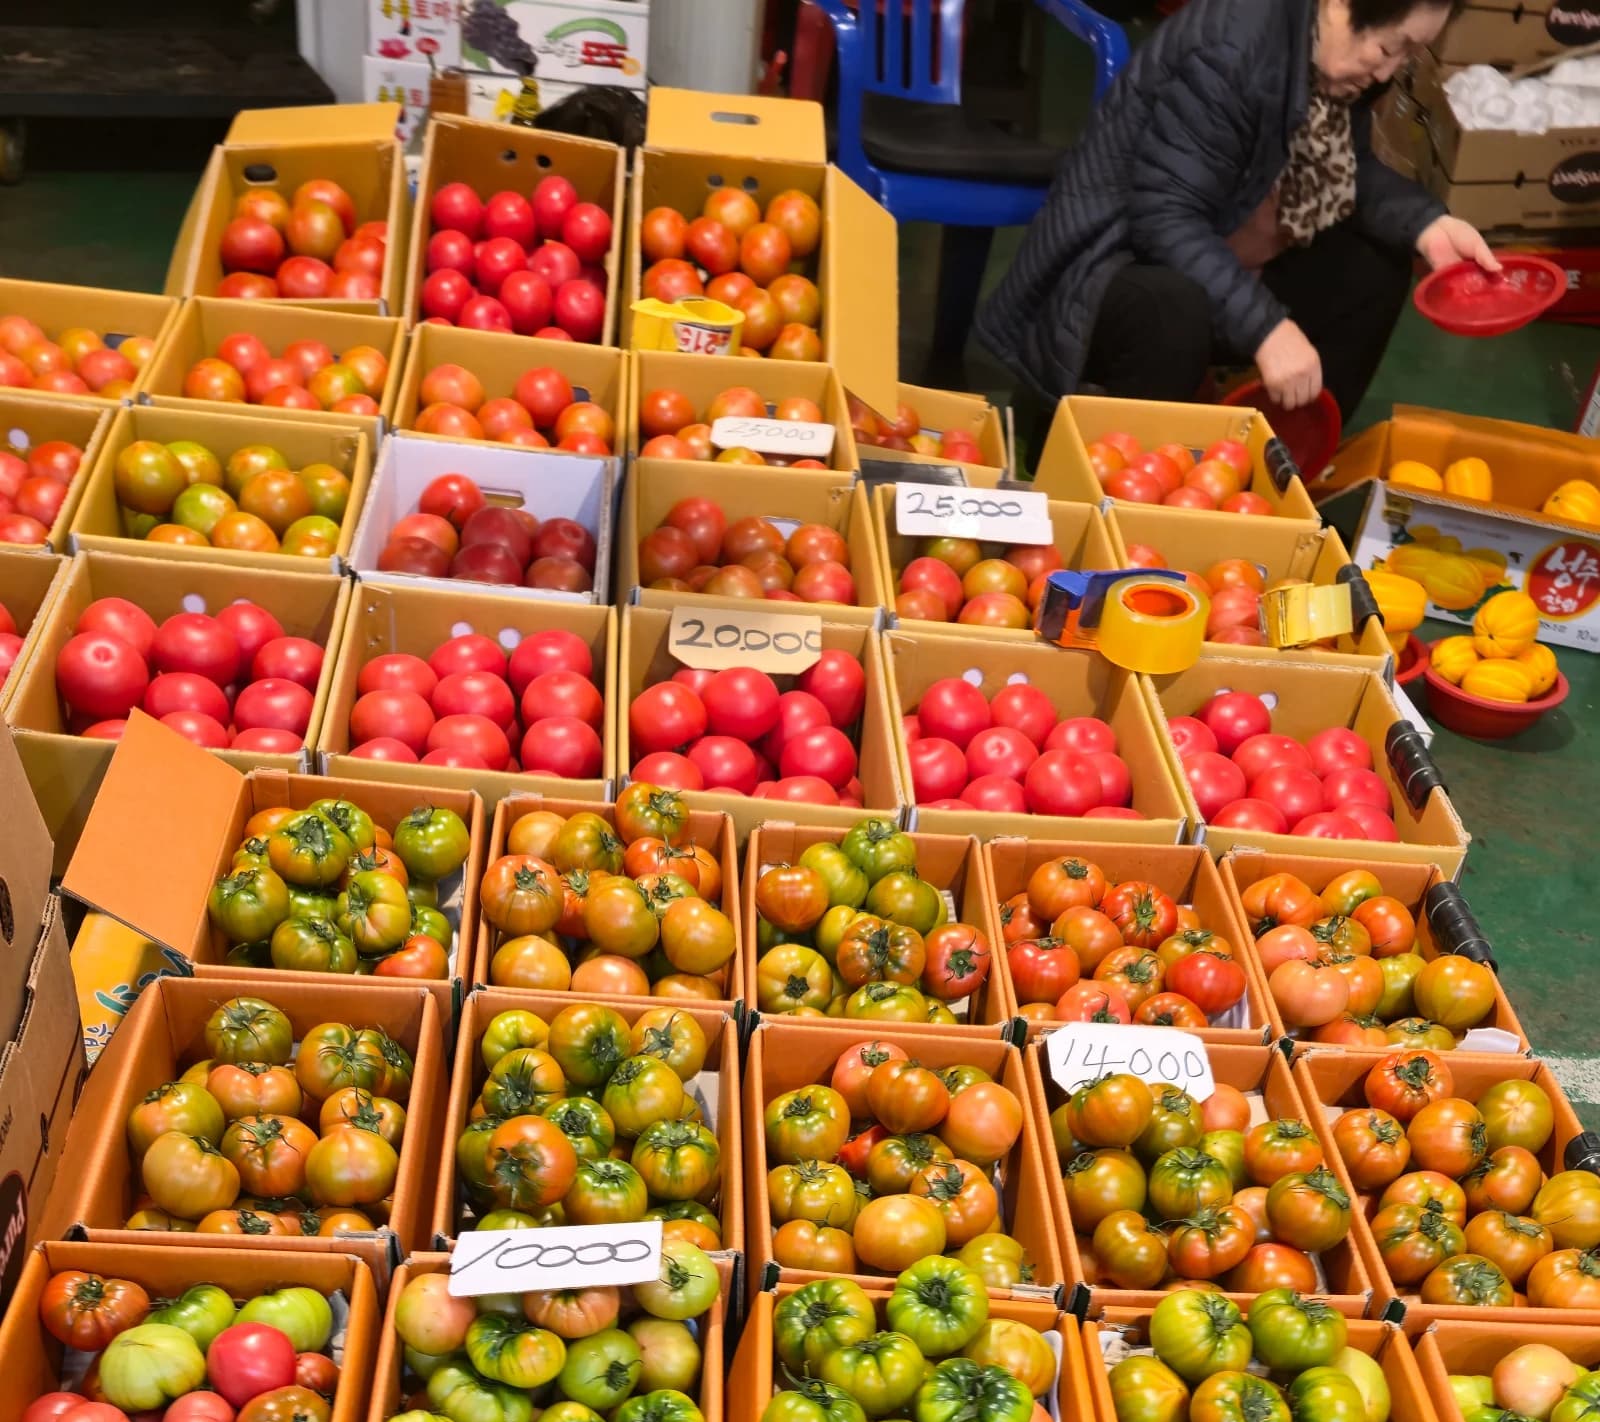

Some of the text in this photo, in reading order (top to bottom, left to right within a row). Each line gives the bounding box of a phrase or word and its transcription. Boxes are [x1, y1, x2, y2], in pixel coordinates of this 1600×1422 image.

[726, 421, 817, 442] 25000
[906, 491, 1023, 518] 25000
[1062, 1038, 1205, 1081] 14000
[450, 1237, 652, 1276] 10000
